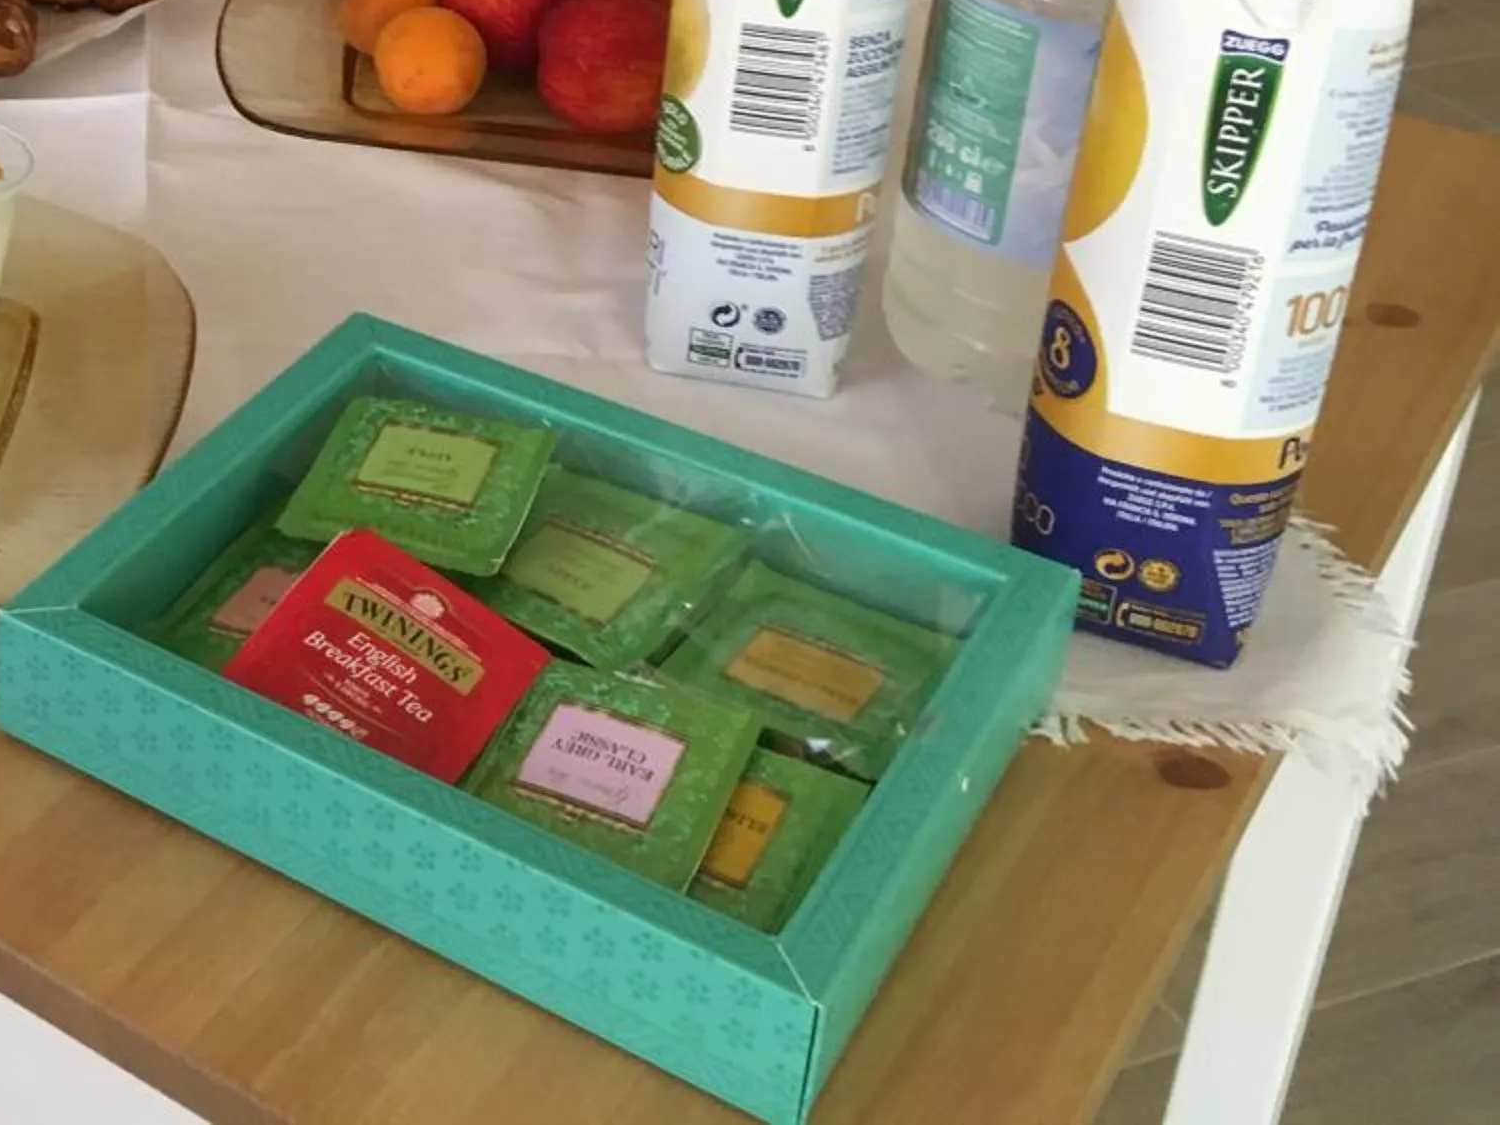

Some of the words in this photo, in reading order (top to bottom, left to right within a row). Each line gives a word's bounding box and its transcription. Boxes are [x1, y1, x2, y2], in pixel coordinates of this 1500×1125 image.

[1222, 35, 1285, 57] ZUEGG
[1206, 66, 1266, 199] SKIPPER
[1285, 284, 1350, 338] 100
[1050, 325, 1071, 369] 8
[342, 592, 466, 684] TWININGS
[347, 632, 418, 684] English
[303, 630, 399, 699] Breakfast
[396, 688, 434, 723] Tea
[549, 737, 601, 762] GREY
[569, 728, 647, 765] CLASSIC
[601, 753, 654, 783] EARL
